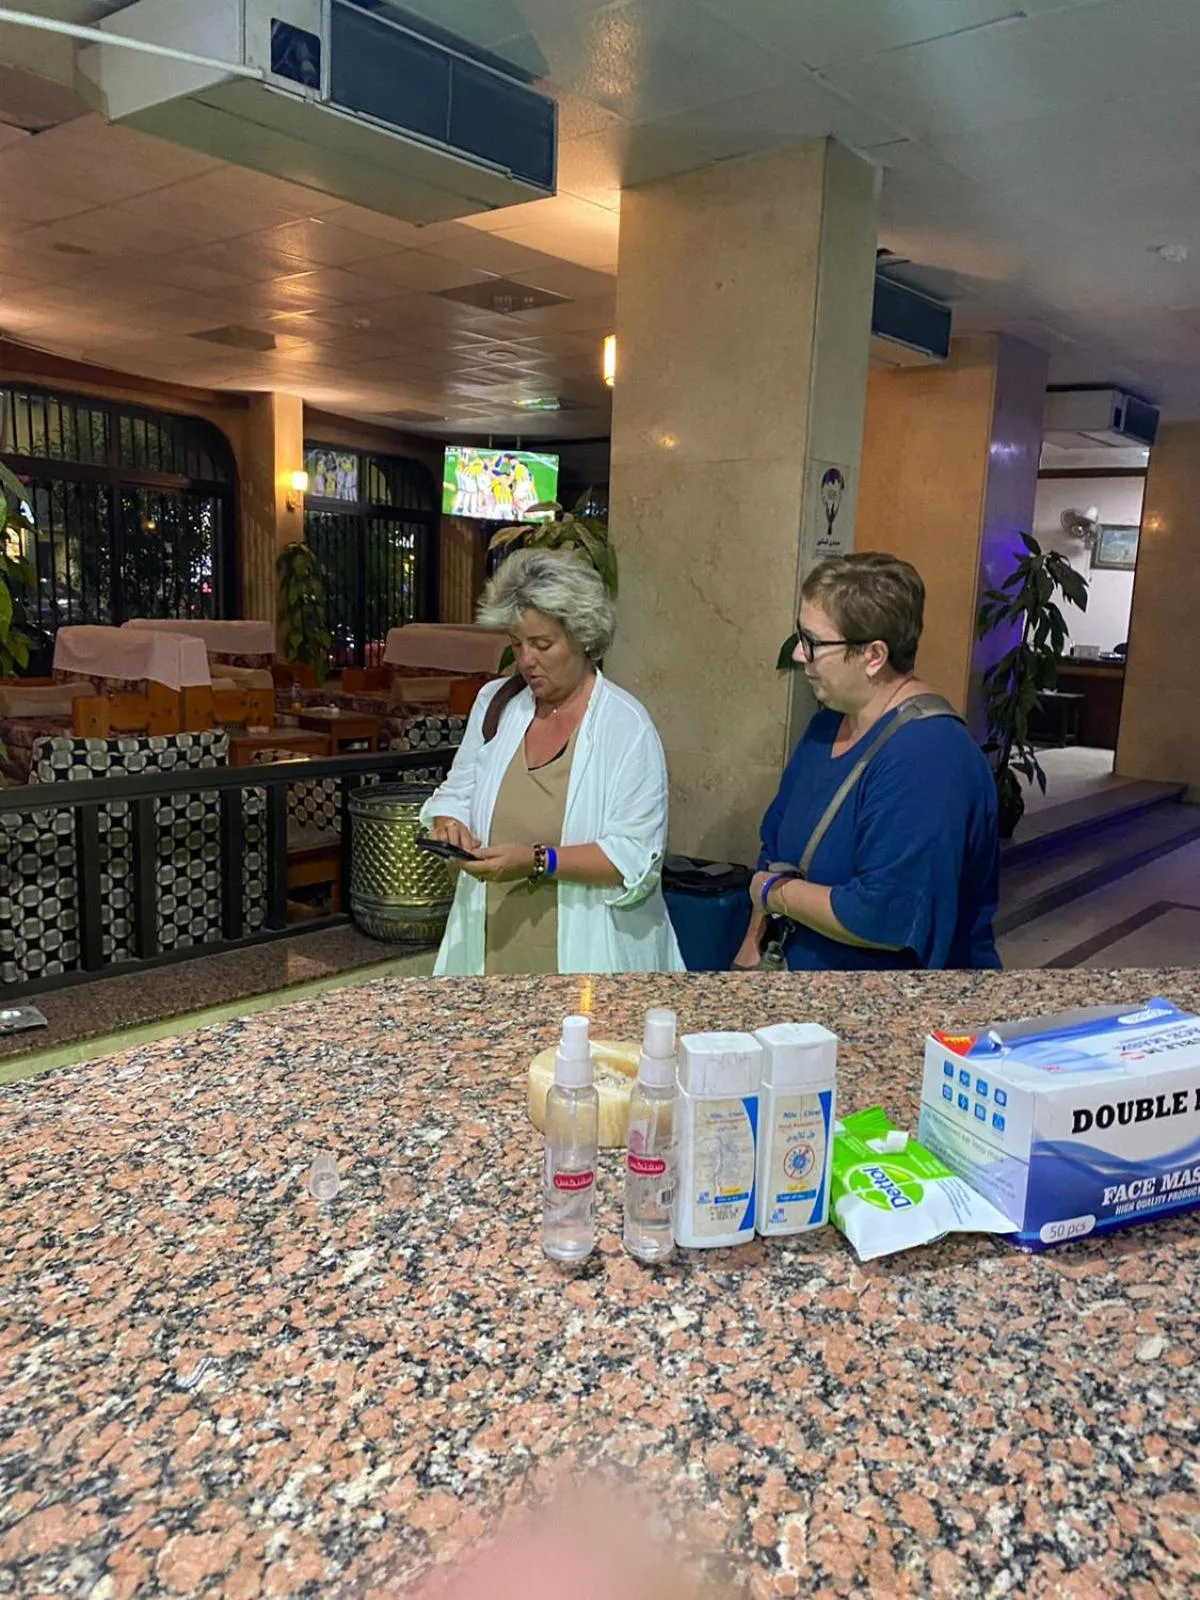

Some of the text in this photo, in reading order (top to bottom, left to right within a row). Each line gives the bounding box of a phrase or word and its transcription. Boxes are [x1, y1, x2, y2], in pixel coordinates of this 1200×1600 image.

[1072, 1091, 1188, 1134] DOUBLE
[862, 1167, 912, 1208] Dettol
[1102, 1177, 1156, 1206] FACE
[1115, 1202, 1135, 1216] HIGH
[1136, 1194, 1167, 1211] QUALITY
[1050, 1223, 1086, 1239] 50 pcs
